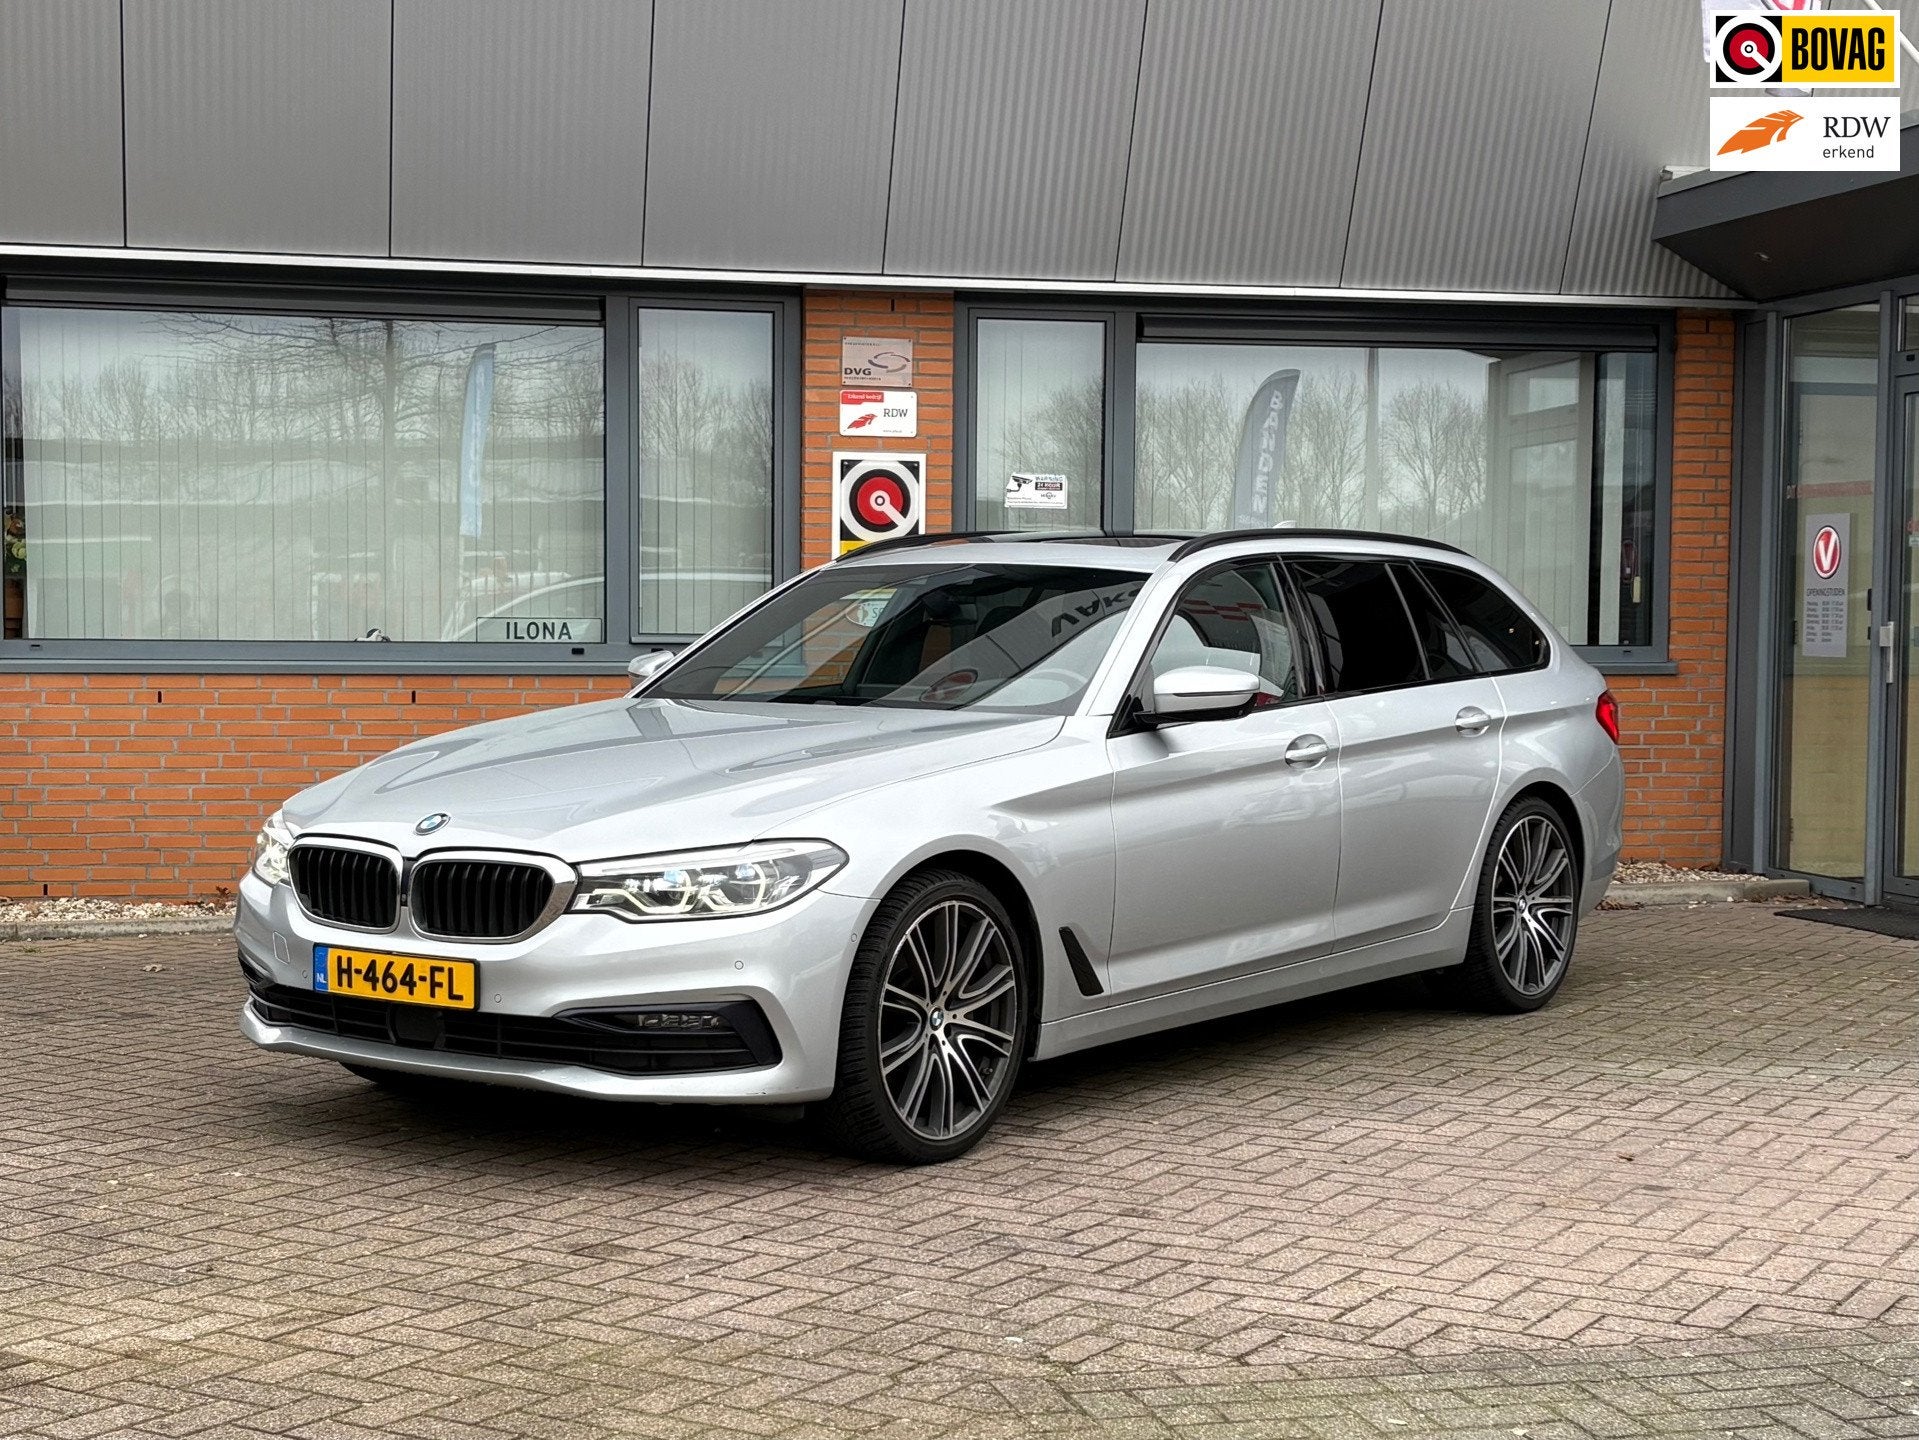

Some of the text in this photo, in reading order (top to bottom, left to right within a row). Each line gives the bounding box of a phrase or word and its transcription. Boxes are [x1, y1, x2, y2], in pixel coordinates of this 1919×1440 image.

[844, 367, 872, 376] DVG
[883, 408, 908, 418] RDW
[506, 621, 572, 640] ILONA
[316, 973, 327, 984] NL
[336, 955, 464, 1001] H-464-FL
